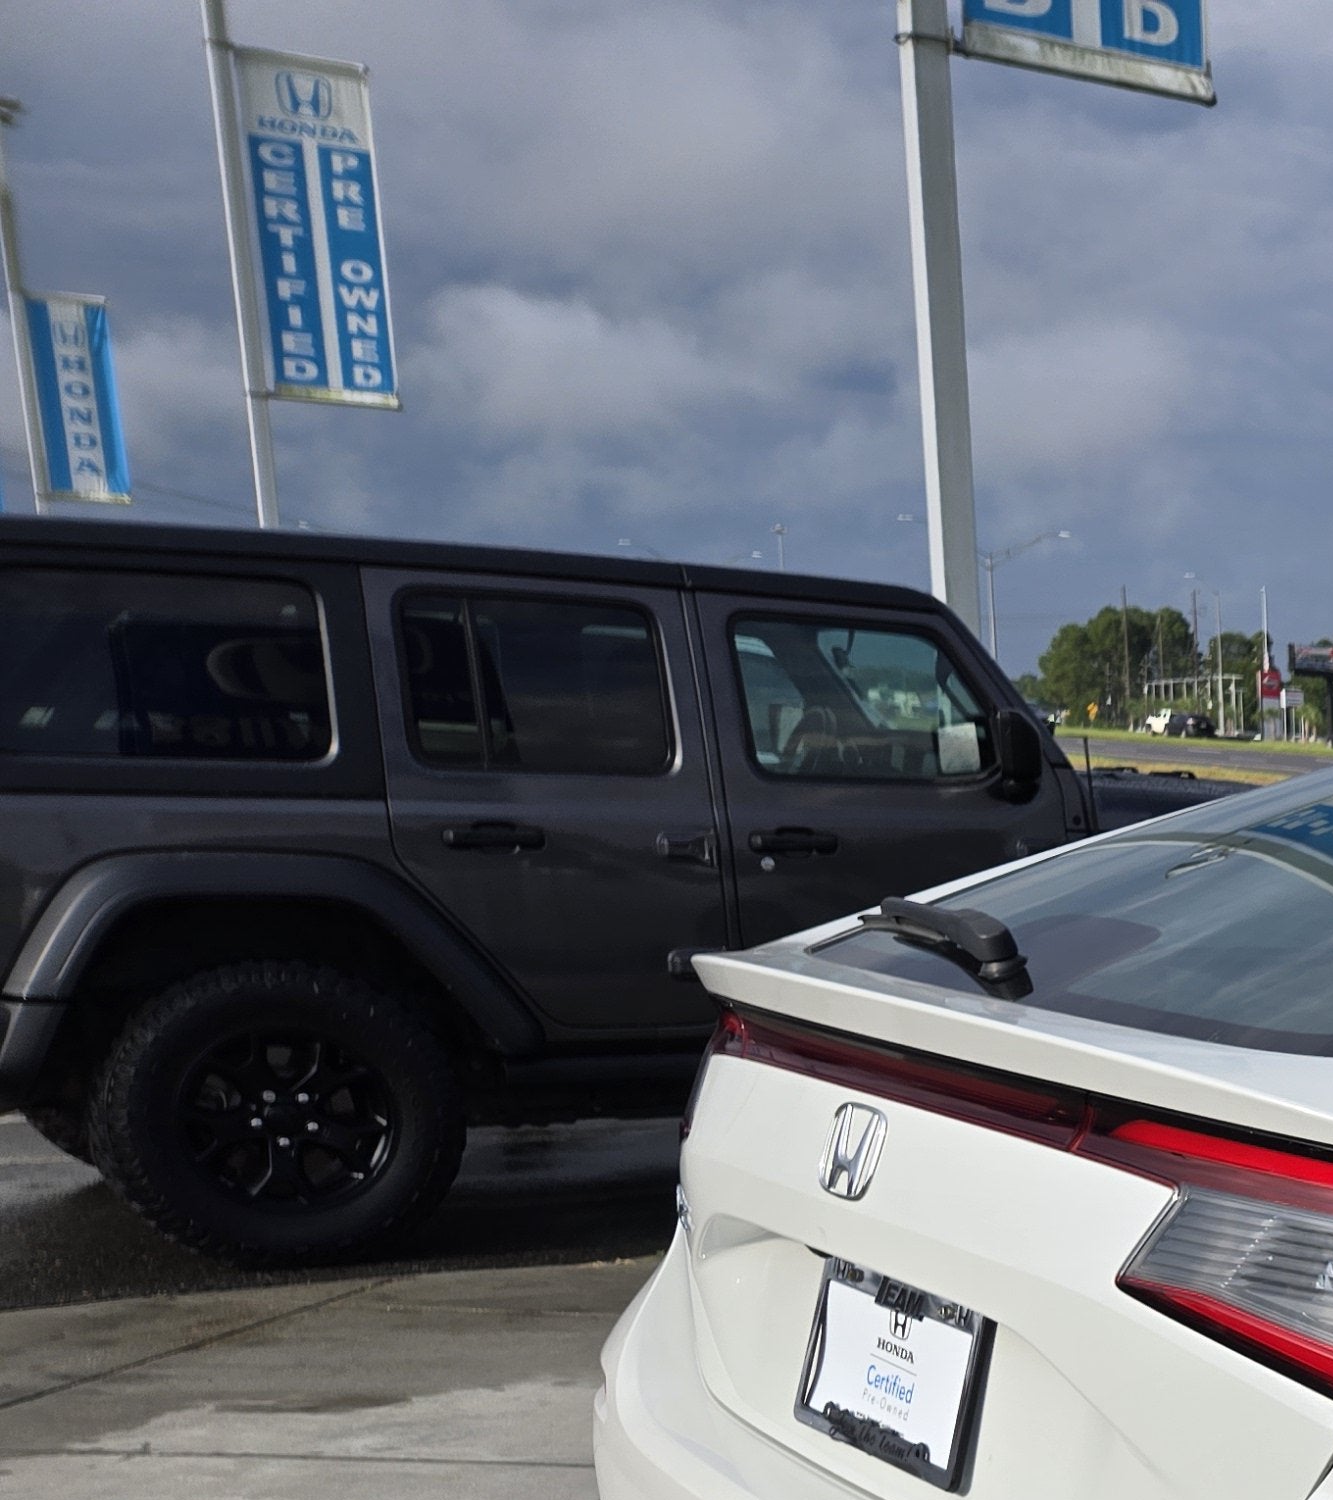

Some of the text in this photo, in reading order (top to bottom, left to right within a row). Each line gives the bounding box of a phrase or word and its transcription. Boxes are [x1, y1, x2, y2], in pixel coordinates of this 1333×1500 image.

[258, 115, 360, 144] HONDA
[258, 142, 319, 381] CERTIFIED
[331, 151, 382, 388] PRE OWNED
[61, 355, 102, 476] HONDA
[877, 1337, 914, 1364] HONDA
[867, 1364, 915, 1404] Certified
[862, 1388, 909, 1421] Pre-Owned
